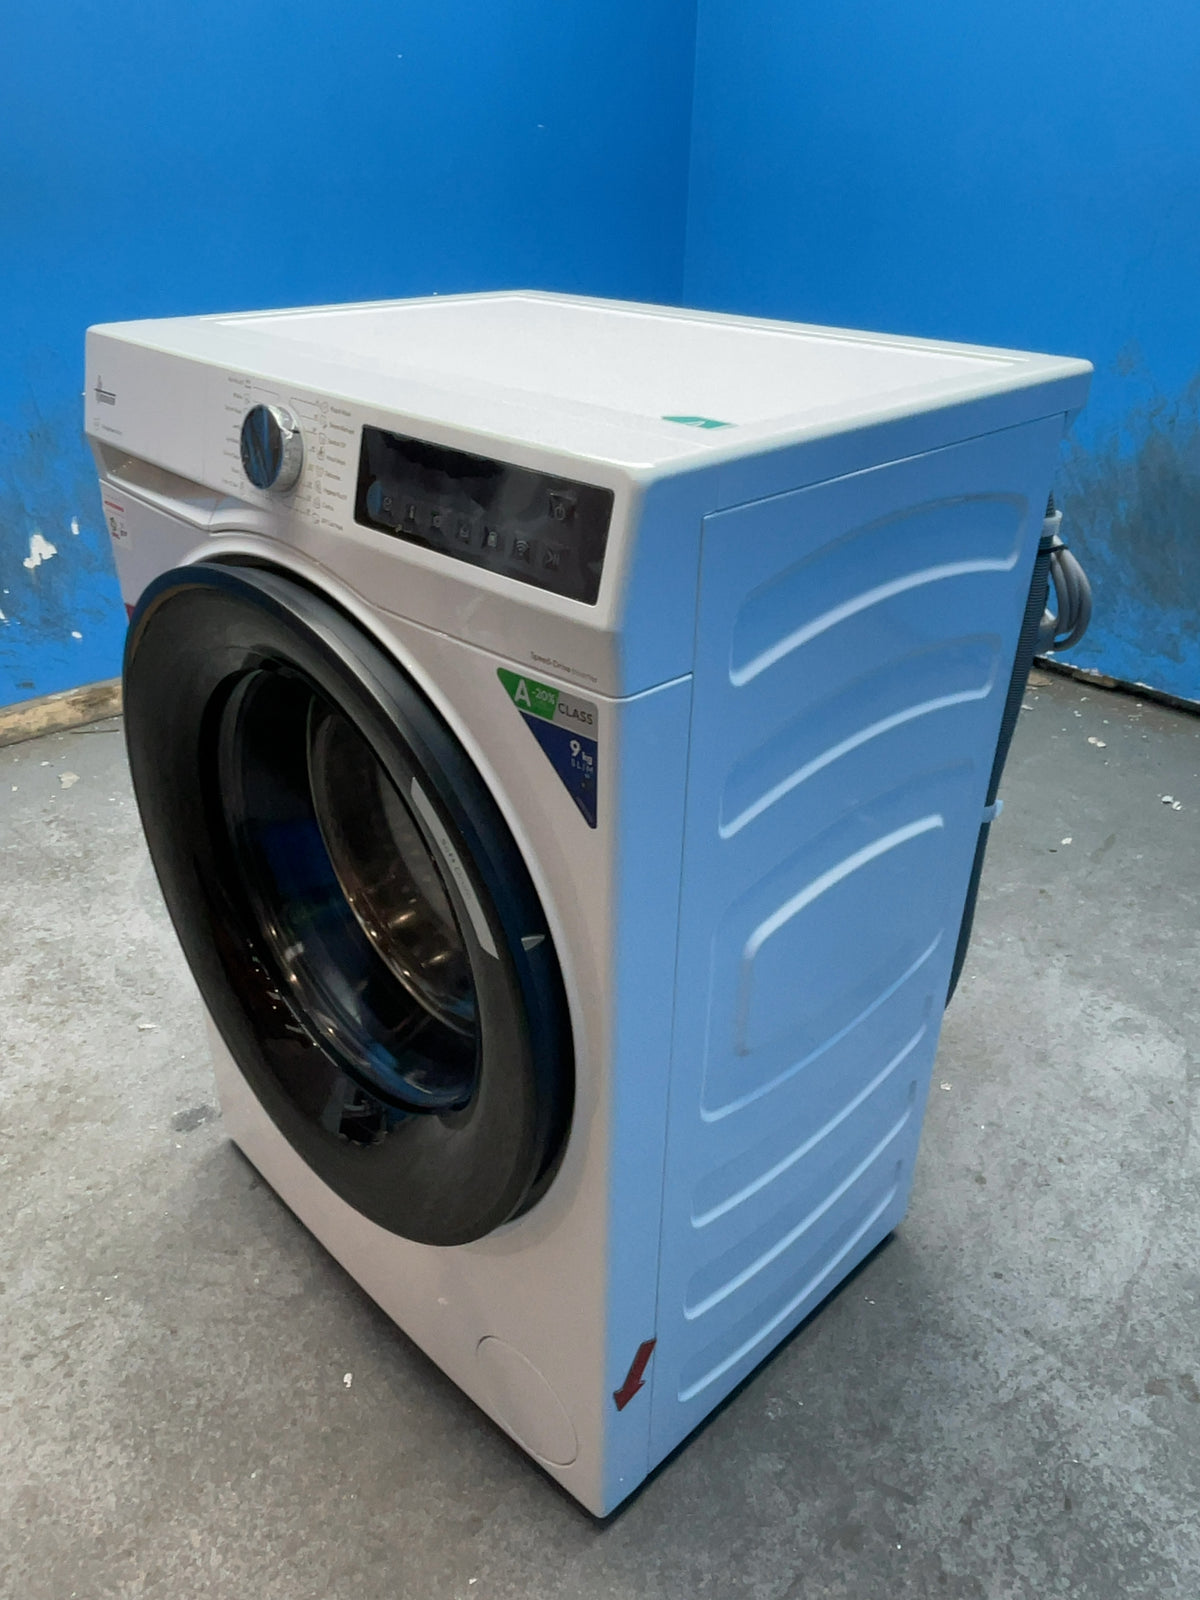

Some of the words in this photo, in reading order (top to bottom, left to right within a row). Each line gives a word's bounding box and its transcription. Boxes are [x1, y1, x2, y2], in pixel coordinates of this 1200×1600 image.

[514, 678, 532, 708] A
[532, 688, 556, 705] -20%
[558, 702, 593, 725] CLASS
[569, 739, 582, 757] 9
